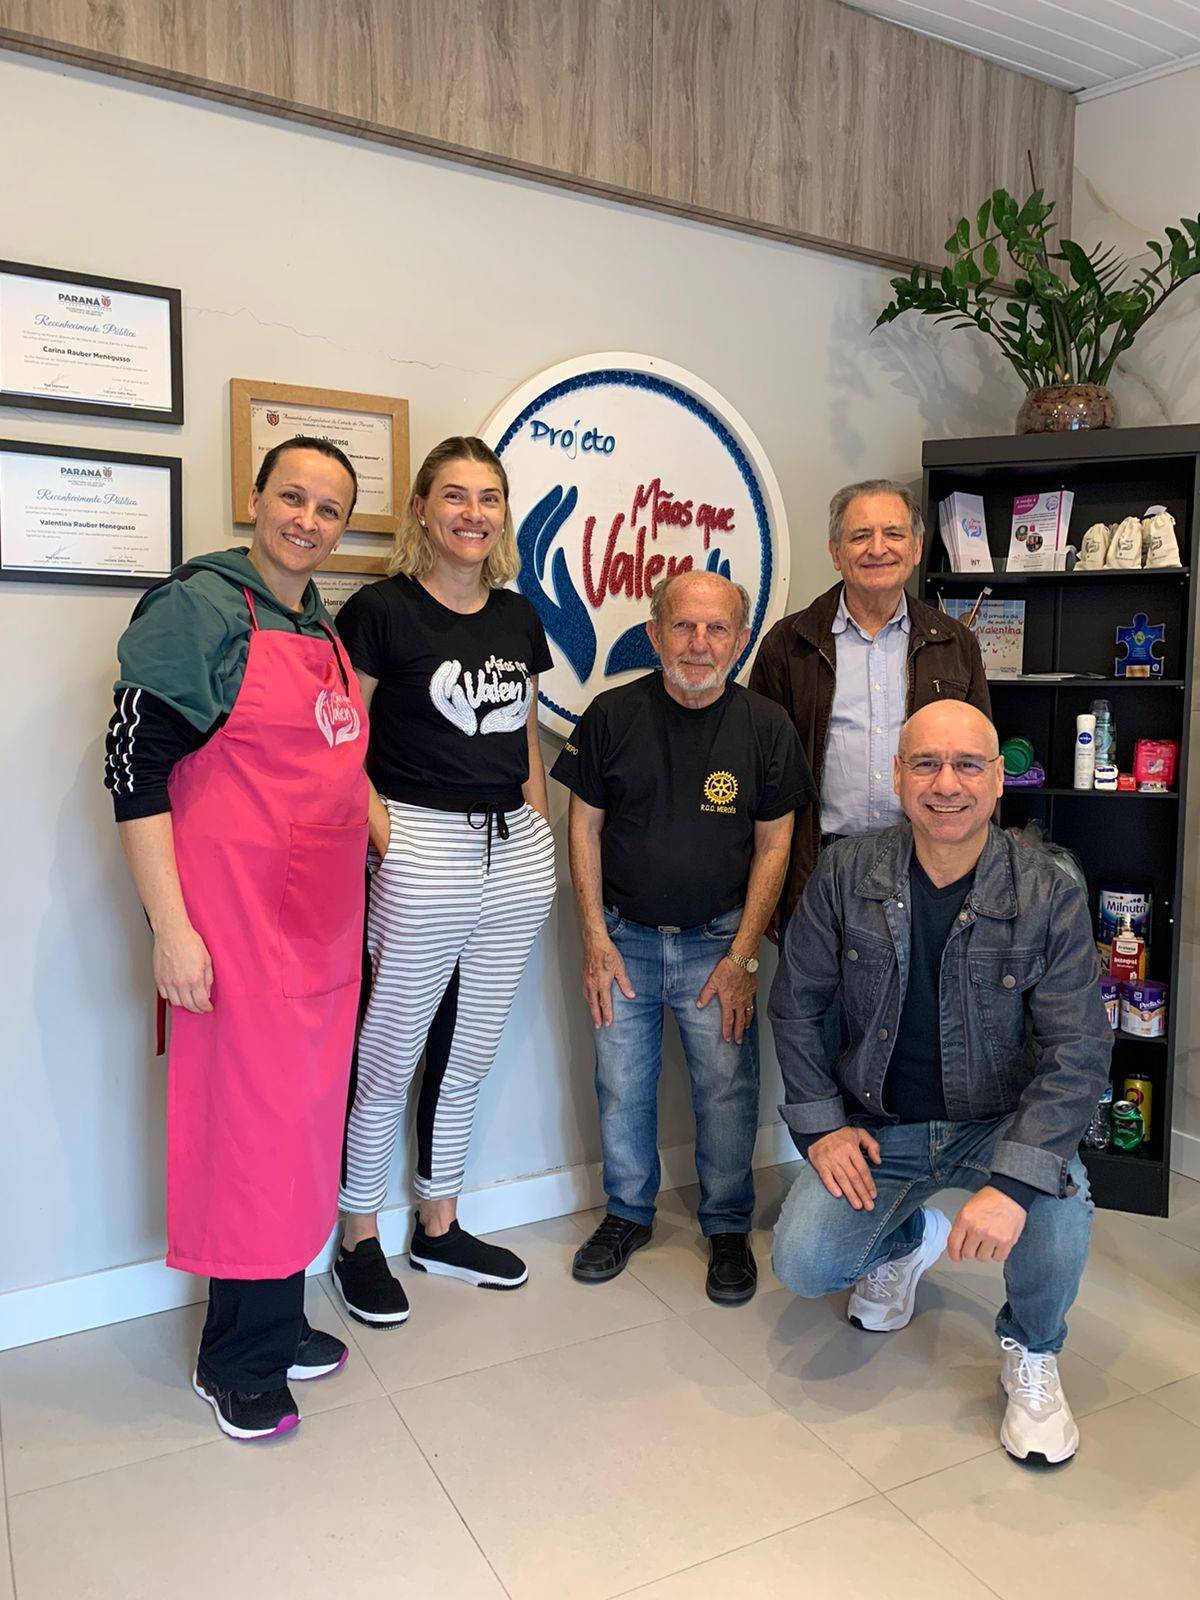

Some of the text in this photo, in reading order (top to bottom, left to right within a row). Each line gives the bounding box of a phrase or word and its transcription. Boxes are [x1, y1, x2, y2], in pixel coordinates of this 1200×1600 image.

[58, 293, 101, 306] PARANÁ
[34, 313, 137, 338] Reconhecimento Público
[42, 346, 131, 363] Carina Rauber Menegusso
[530, 419, 616, 460] Projeto
[60, 466, 102, 478] PARANÁ
[36, 488, 138, 506] Reconhecimento Público
[630, 477, 736, 550] Mãos que
[39, 518, 136, 531] Valentina Rauber Menegusso
[980, 624, 1021, 635] Valentina
[464, 669, 523, 709] Valen
[1107, 900, 1146, 914] Milnutri
[1114, 957, 1137, 966] Integral
